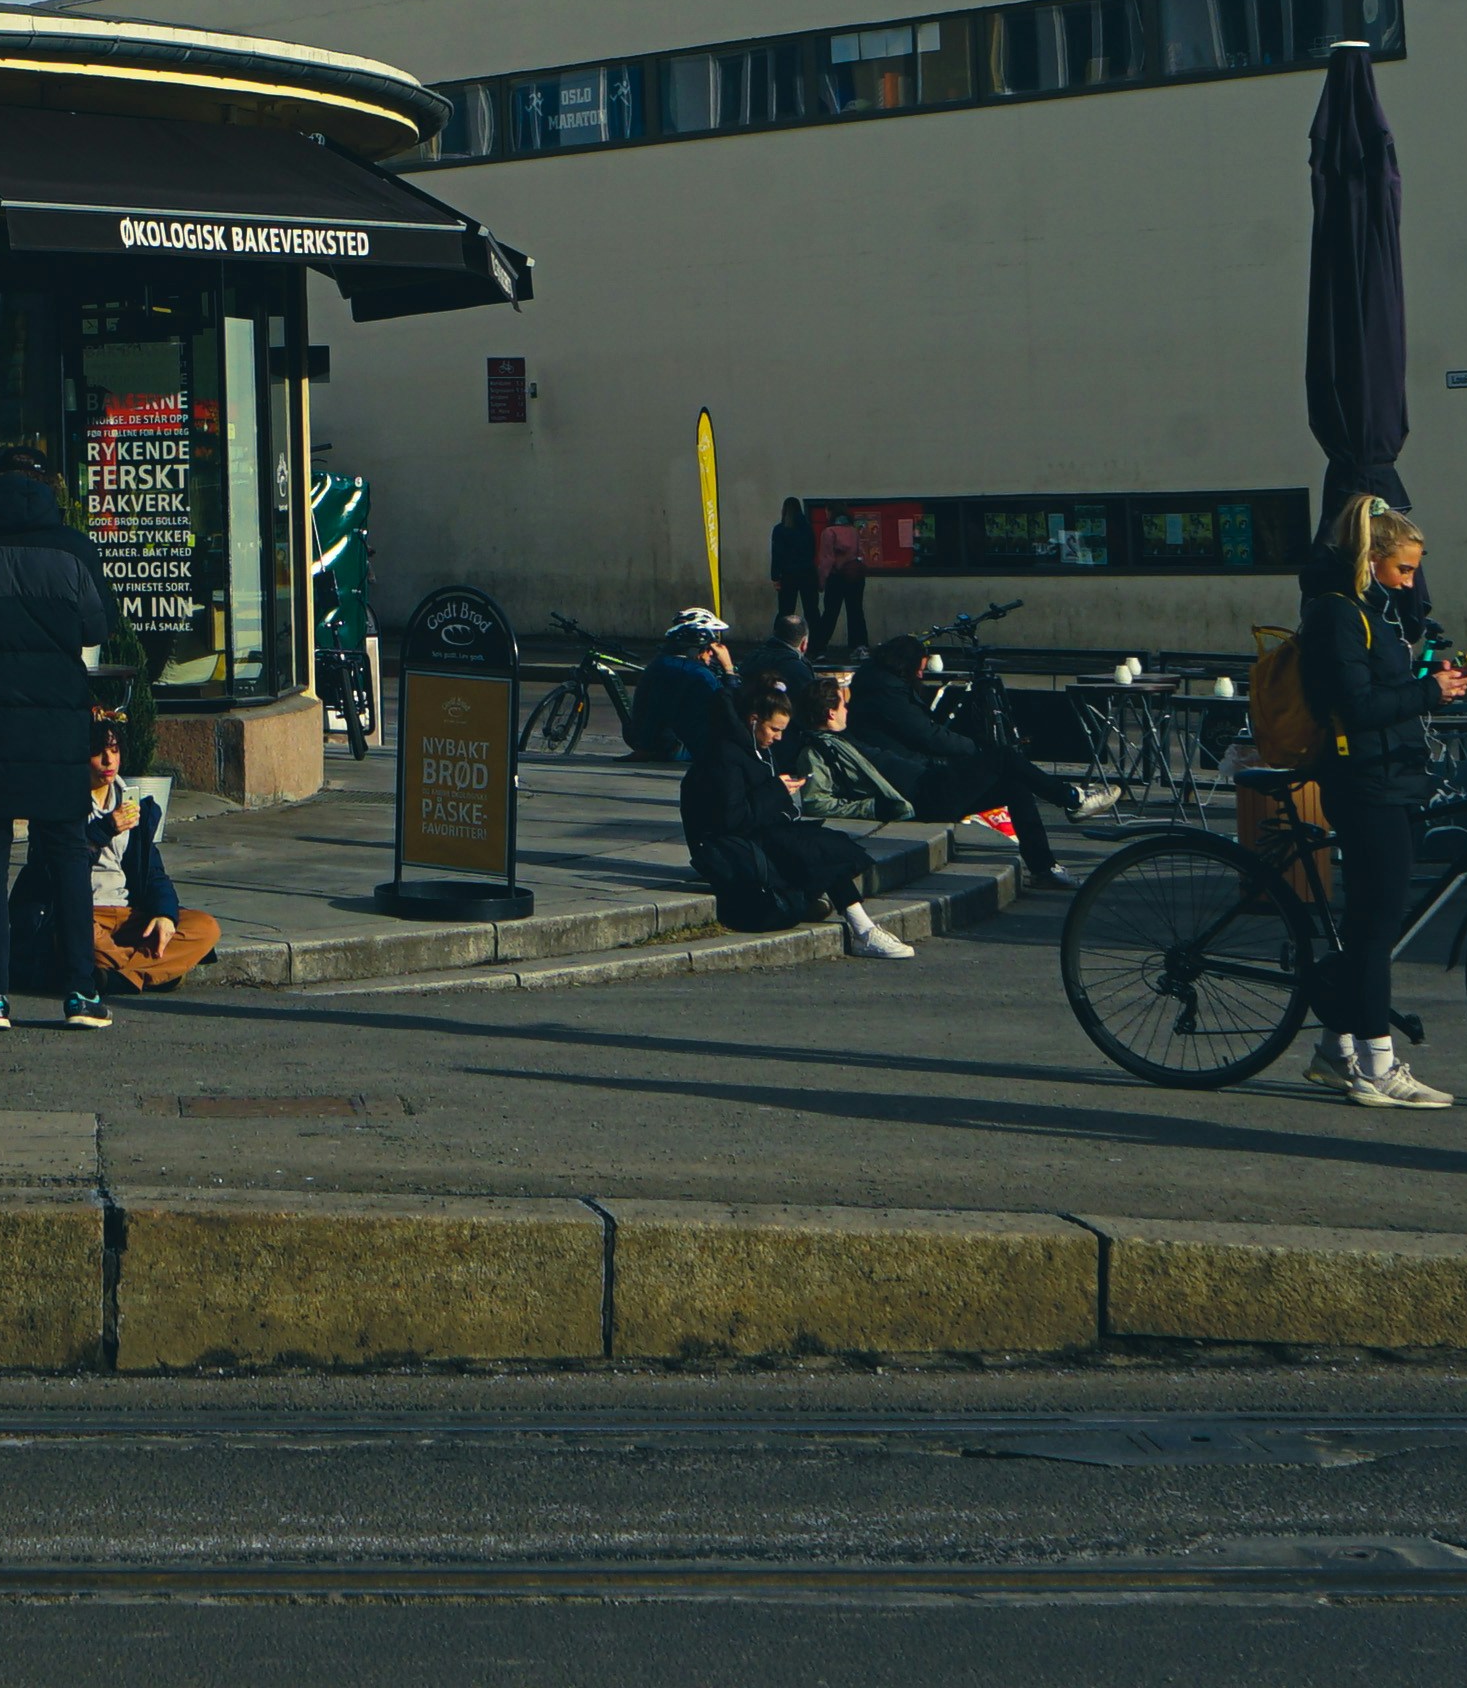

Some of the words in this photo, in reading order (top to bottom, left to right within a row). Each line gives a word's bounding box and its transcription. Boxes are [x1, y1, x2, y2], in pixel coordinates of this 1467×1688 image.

[560, 87, 592, 105] OSLO
[120, 216, 228, 249] ØKOLOGISK
[231, 227, 370, 256] BAKEVERKSTED
[129, 415, 143, 425] DE
[144, 411, 167, 424] STÅR
[169, 413, 189, 424] OPP
[87, 440, 190, 461] RYKENDE
[87, 463, 190, 490] FERSKT
[87, 493, 192, 513] BAKVERK.
[88, 517, 112, 526] GODE
[140, 517, 154, 526] OG
[88, 529, 193, 543] RUNDSTYKKER
[105, 547, 141, 558] KAKER.
[142, 546, 168, 557] BAKT
[170, 546, 192, 557] MED
[102, 561, 193, 578] KOLOGISK
[125, 582, 164, 592] FINESTE
[165, 581, 193, 592] SORT.
[152, 596, 194, 618] INN
[145, 620, 157, 632] FÅ
[158, 621, 194, 632] SMAKE.
[426, 601, 458, 631] Godt
[459, 601, 494, 634] Brød
[422, 736, 490, 760] NYBAKT
[422, 757, 489, 791] BRØD
[421, 796, 489, 825] PÅSKE-
[421, 822, 489, 841] FAVORITTER!
